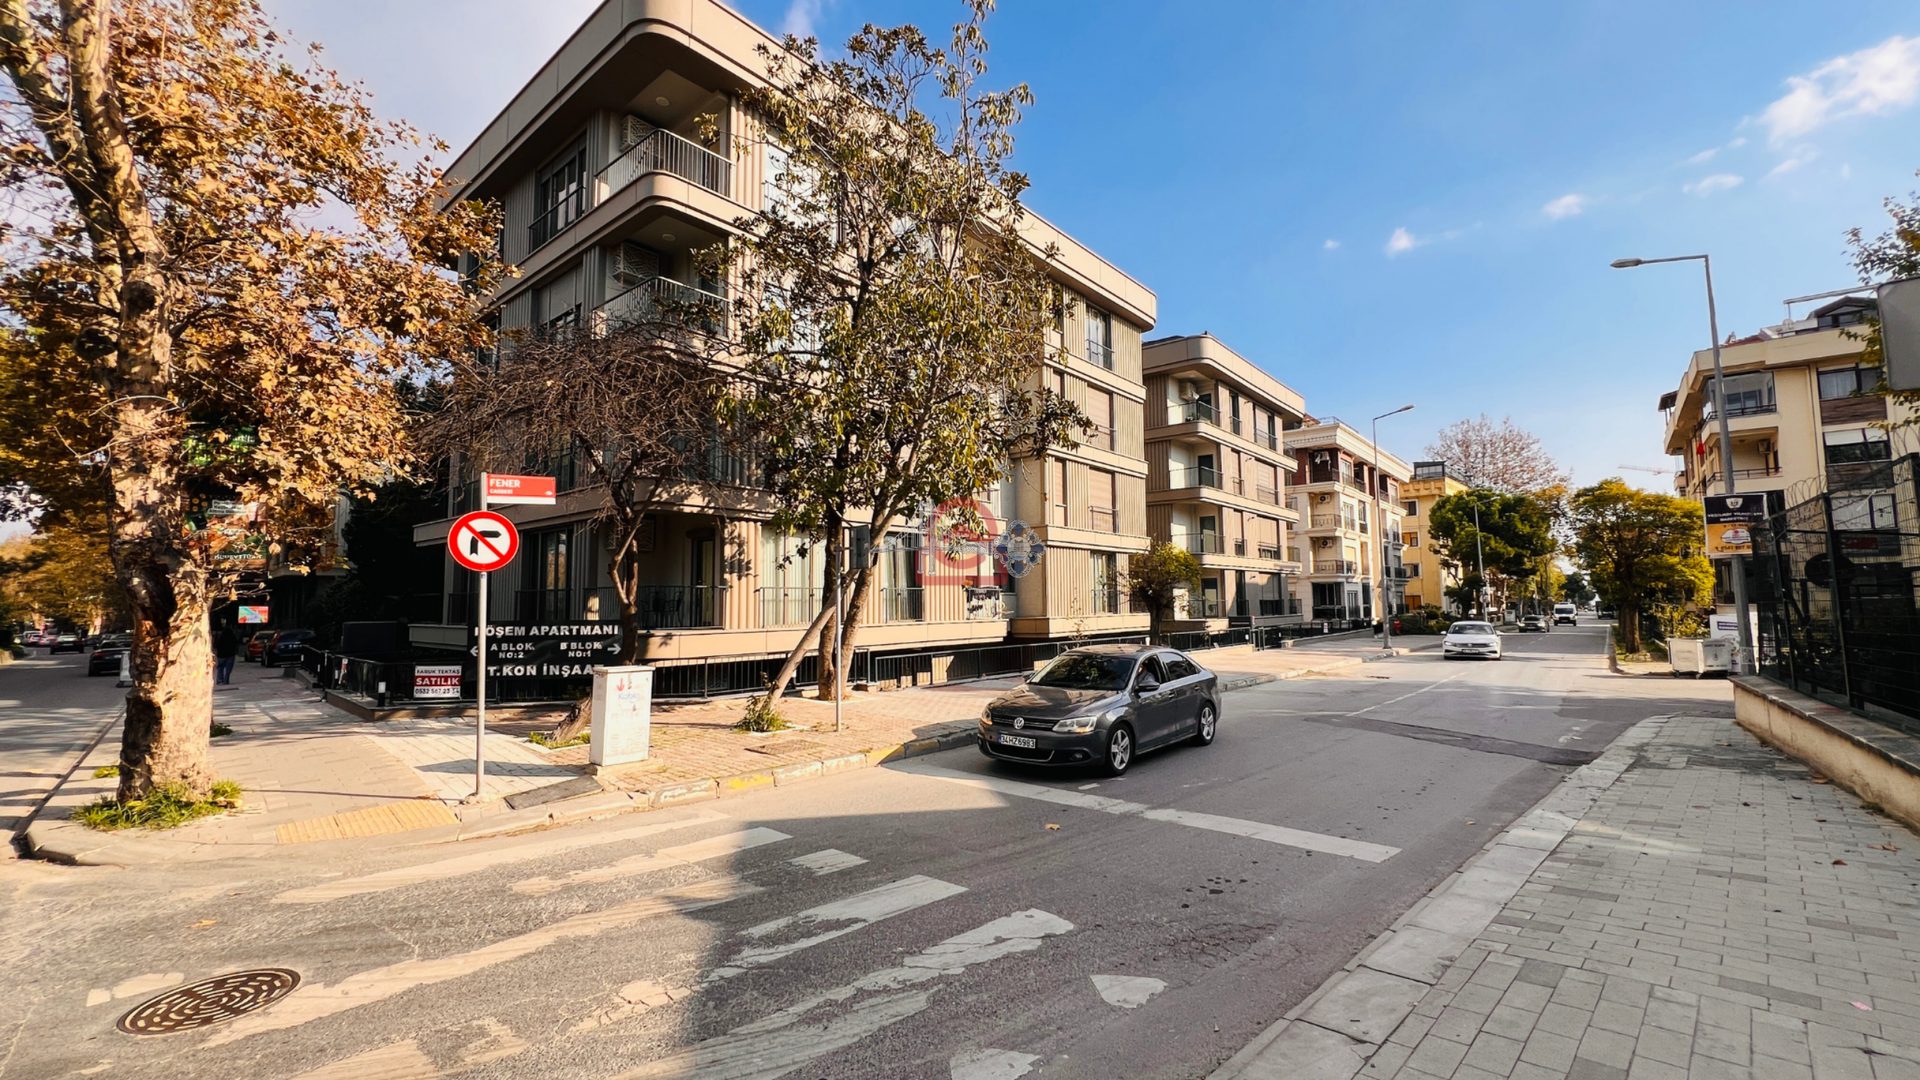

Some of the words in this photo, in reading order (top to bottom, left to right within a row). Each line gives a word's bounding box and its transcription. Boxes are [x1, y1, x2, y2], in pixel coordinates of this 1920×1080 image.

[489, 478, 521, 488] FENER
[529, 624, 619, 636] APARTMANI
[490, 643, 498, 651] A
[501, 642, 534, 650] BLOK
[560, 642, 569, 650] B
[570, 641, 603, 650] BLOK
[499, 651, 525, 659] NO:2
[568, 650, 591, 658] NO:1
[542, 663, 604, 677] İNŞAA
[415, 677, 460, 685] SATILIK
